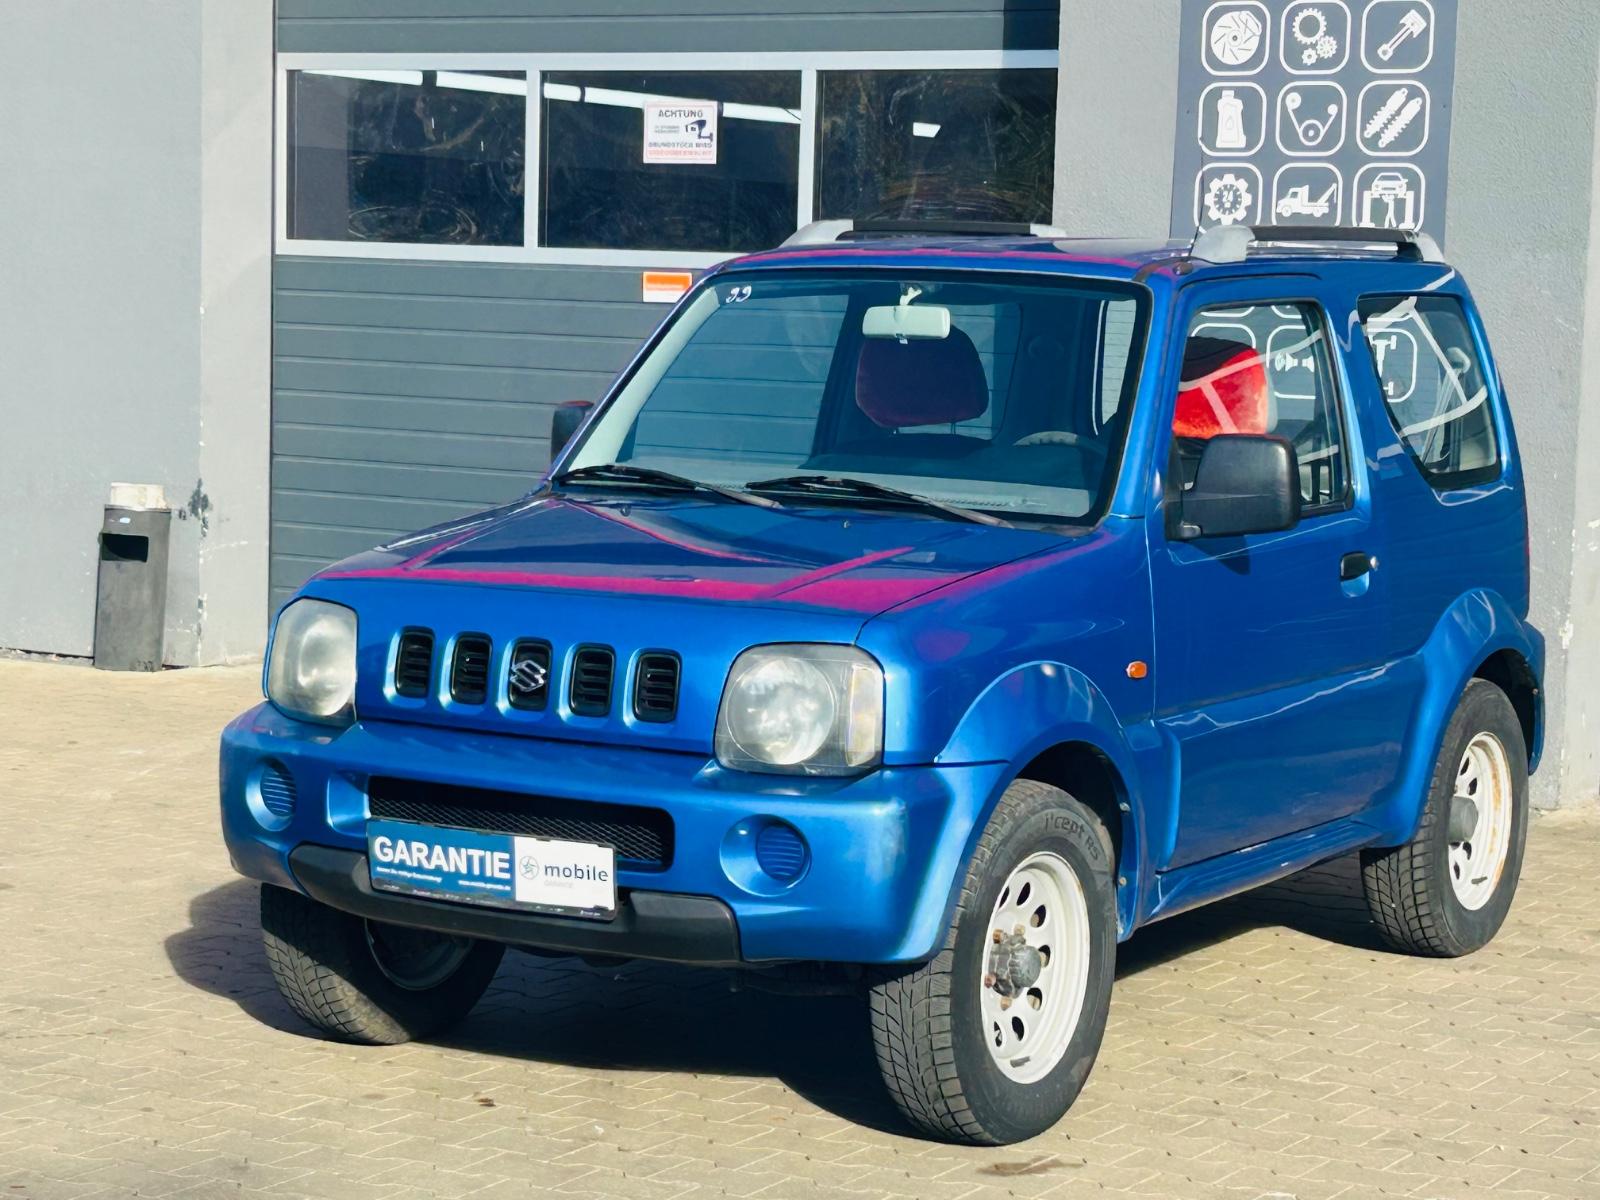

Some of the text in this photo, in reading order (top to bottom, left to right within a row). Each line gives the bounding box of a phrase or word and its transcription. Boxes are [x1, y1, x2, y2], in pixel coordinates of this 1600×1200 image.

[658, 109, 704, 118] ACHTUNG
[374, 836, 511, 879] GARANTIE
[544, 863, 609, 882] mobile
